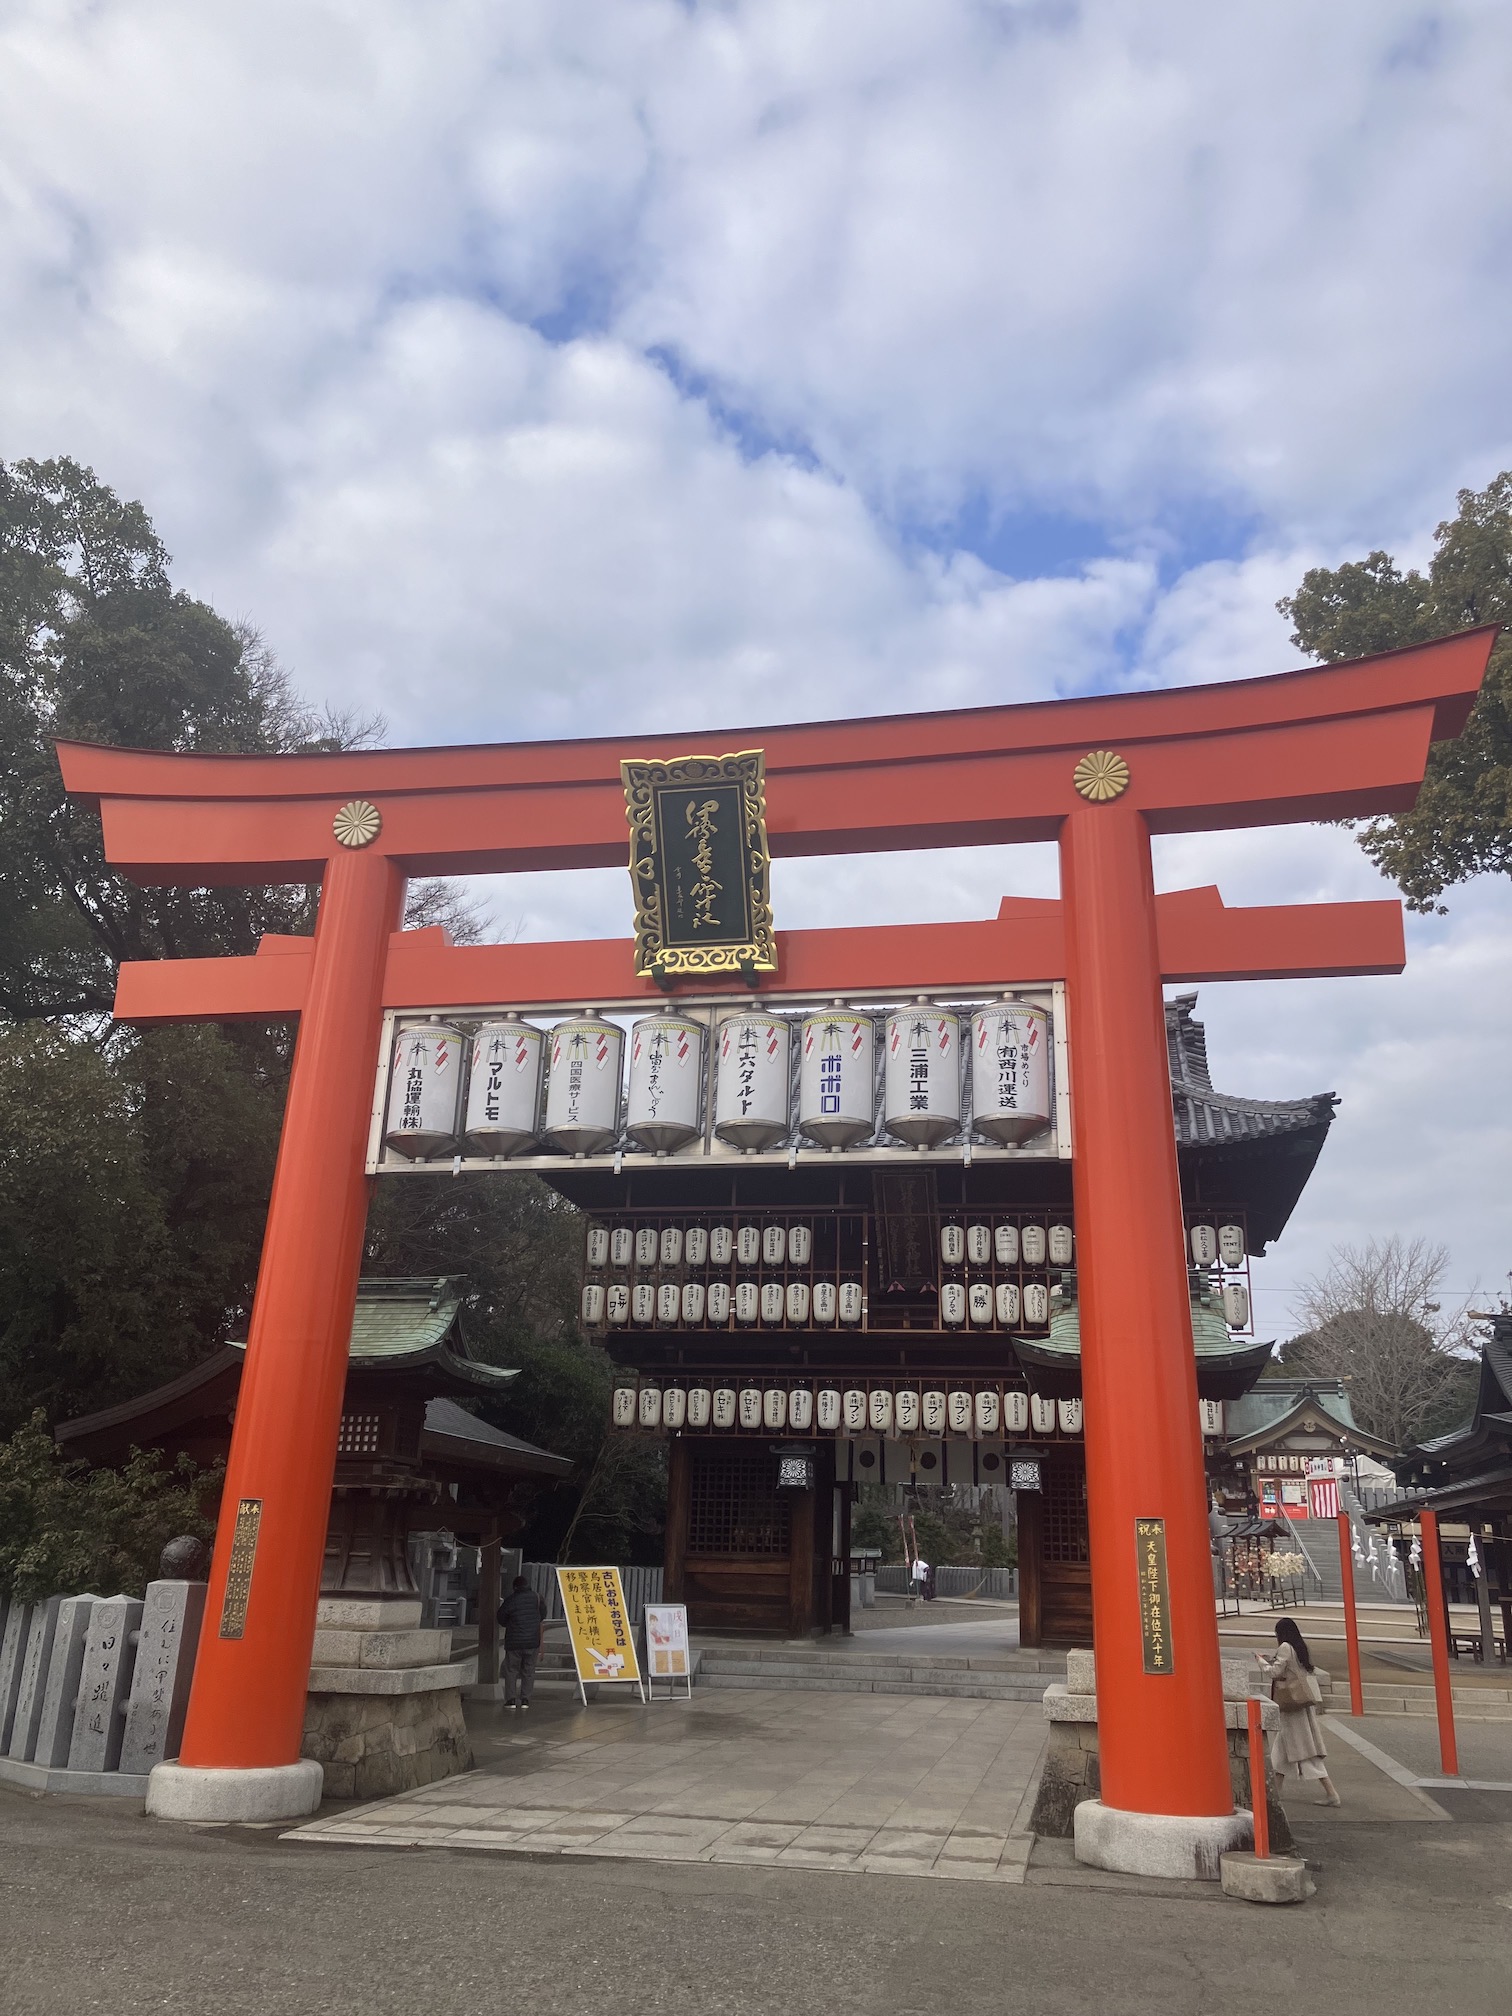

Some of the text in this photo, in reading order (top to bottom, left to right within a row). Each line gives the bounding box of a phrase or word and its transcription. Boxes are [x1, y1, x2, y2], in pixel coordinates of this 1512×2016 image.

[485, 1061, 504, 1121] マルトモ
[567, 1060, 583, 1123] 四国医療サービス
[820, 1054, 843, 1114] ポポロ
[908, 1047, 930, 1111] 三浦工業
[1020, 1043, 1031, 1088] 市場めぐり
[565, 1572, 590, 1641] 移動しました。
[578, 1571, 602, 1646] 警察官詰所横に
[590, 1571, 607, 1608] 鳥居前、
[602, 1571, 627, 1647] 古いお札・お守りは
[1146, 1541, 1164, 1667] 天皇陛下御在位六十年
